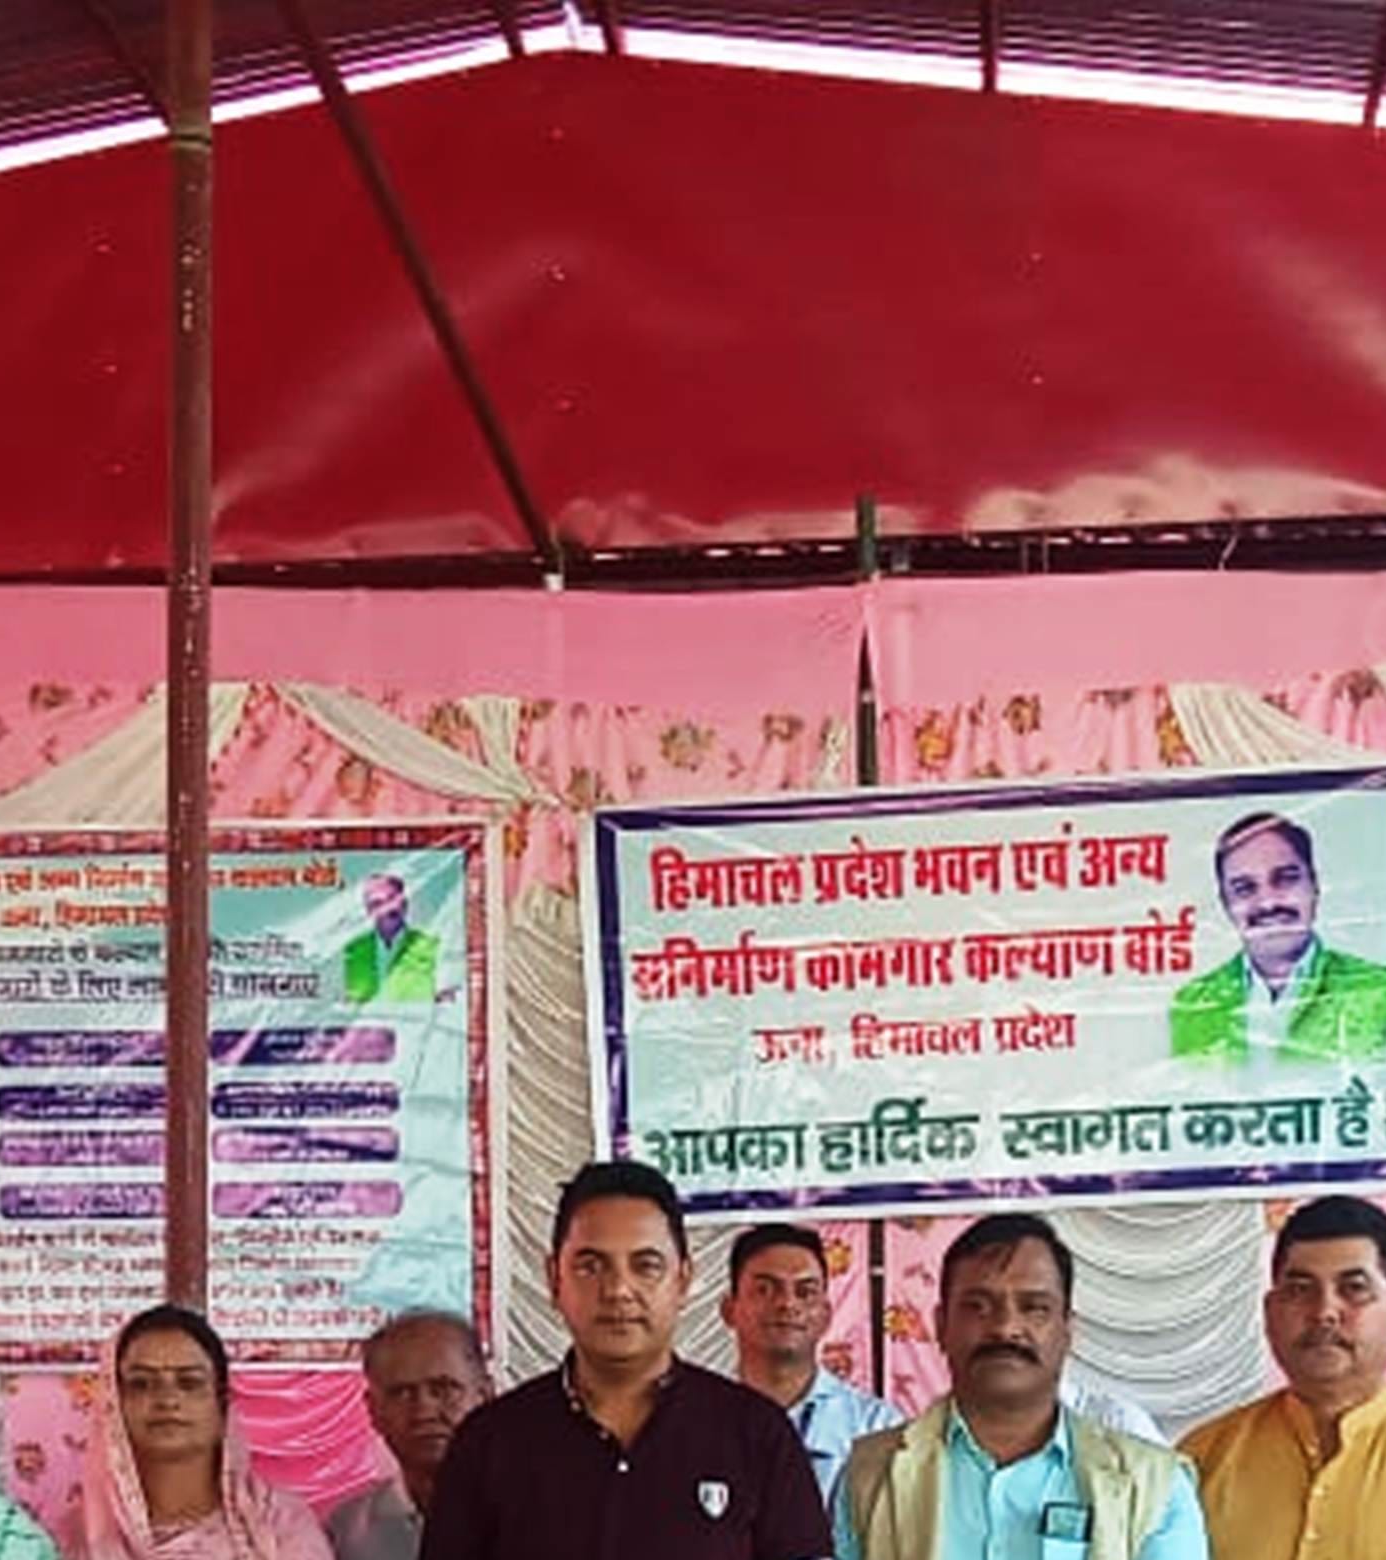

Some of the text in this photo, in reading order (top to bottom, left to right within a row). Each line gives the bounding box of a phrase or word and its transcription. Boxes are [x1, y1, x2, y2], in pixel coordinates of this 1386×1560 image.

[650, 822, 1169, 912] हिमाचल प्रदेश भवन एवं अन्य
[804, 938, 956, 991] कामगार
[962, 927, 1118, 984] कल्याण
[1122, 905, 1197, 975] बोर्ड
[849, 1012, 983, 1061] हिमाचल
[992, 1005, 1077, 1053] प्रदेश
[642, 1124, 808, 1176] आपका
[814, 1096, 981, 1173] हार्दिक
[1000, 1105, 1173, 1158] स्वागत
[1181, 1097, 1326, 1150] करता
[1331, 1073, 1376, 1148] है
